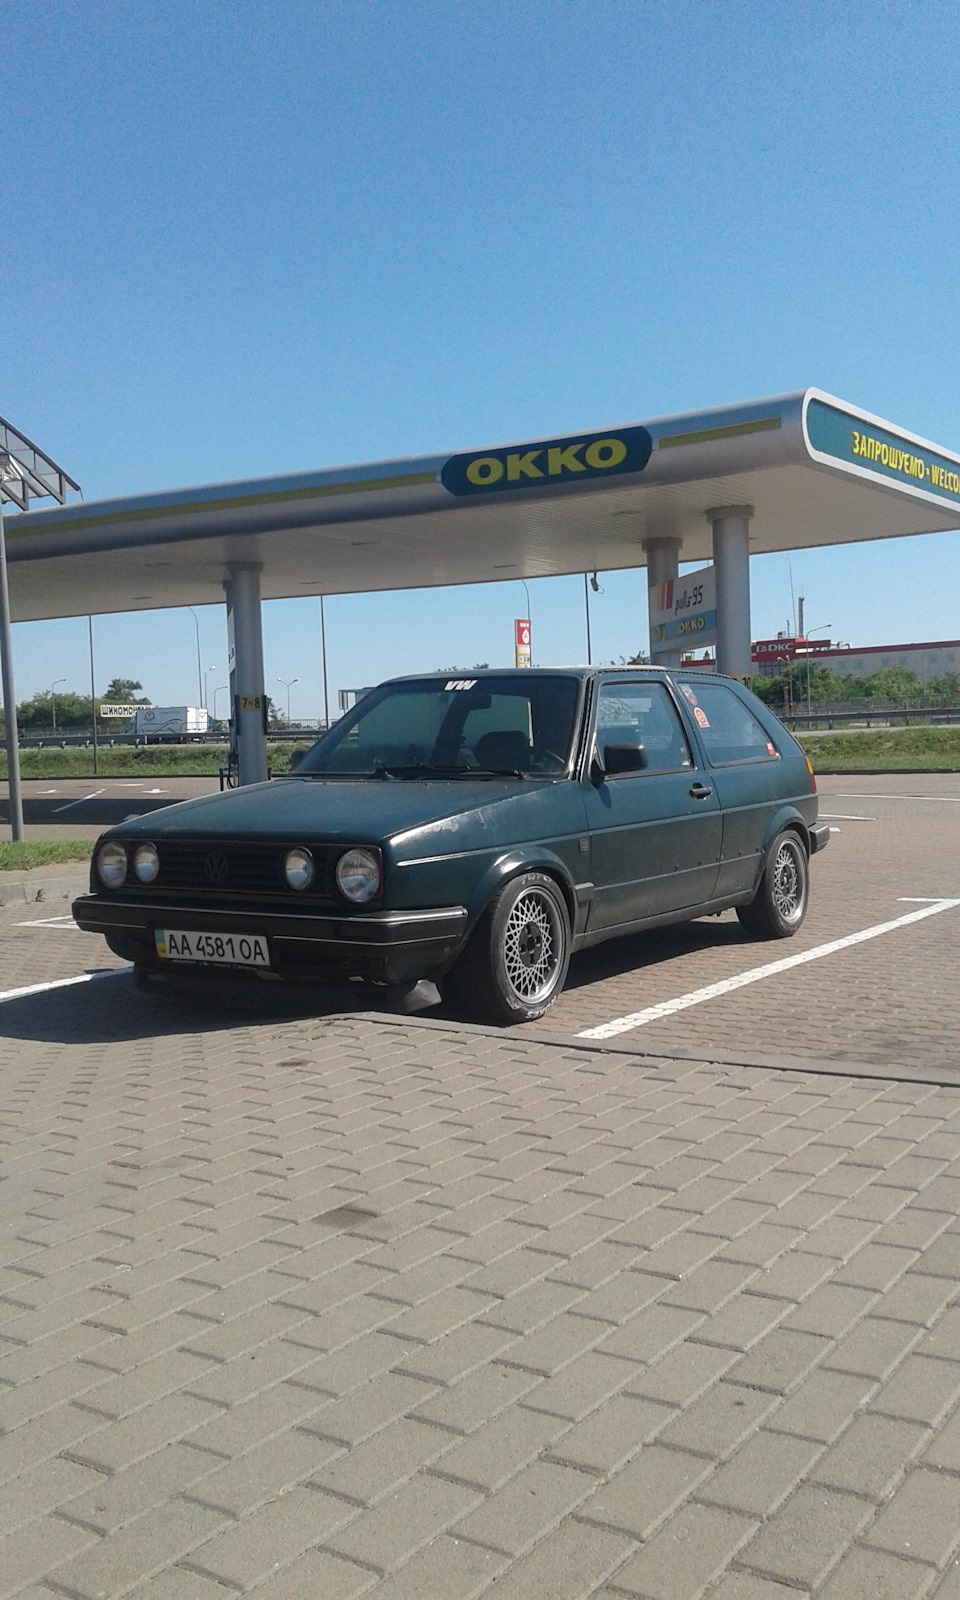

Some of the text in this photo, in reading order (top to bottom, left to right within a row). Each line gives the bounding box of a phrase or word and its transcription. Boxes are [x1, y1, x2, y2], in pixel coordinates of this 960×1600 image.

[466, 438, 627, 486] OKKO
[852, 431, 960, 494] ЗАПРОШУЄМО WELCO
[678, 617, 705, 634] OKKO
[444, 679, 478, 691] VW
[168, 934, 266, 962] AA 4581 OA
